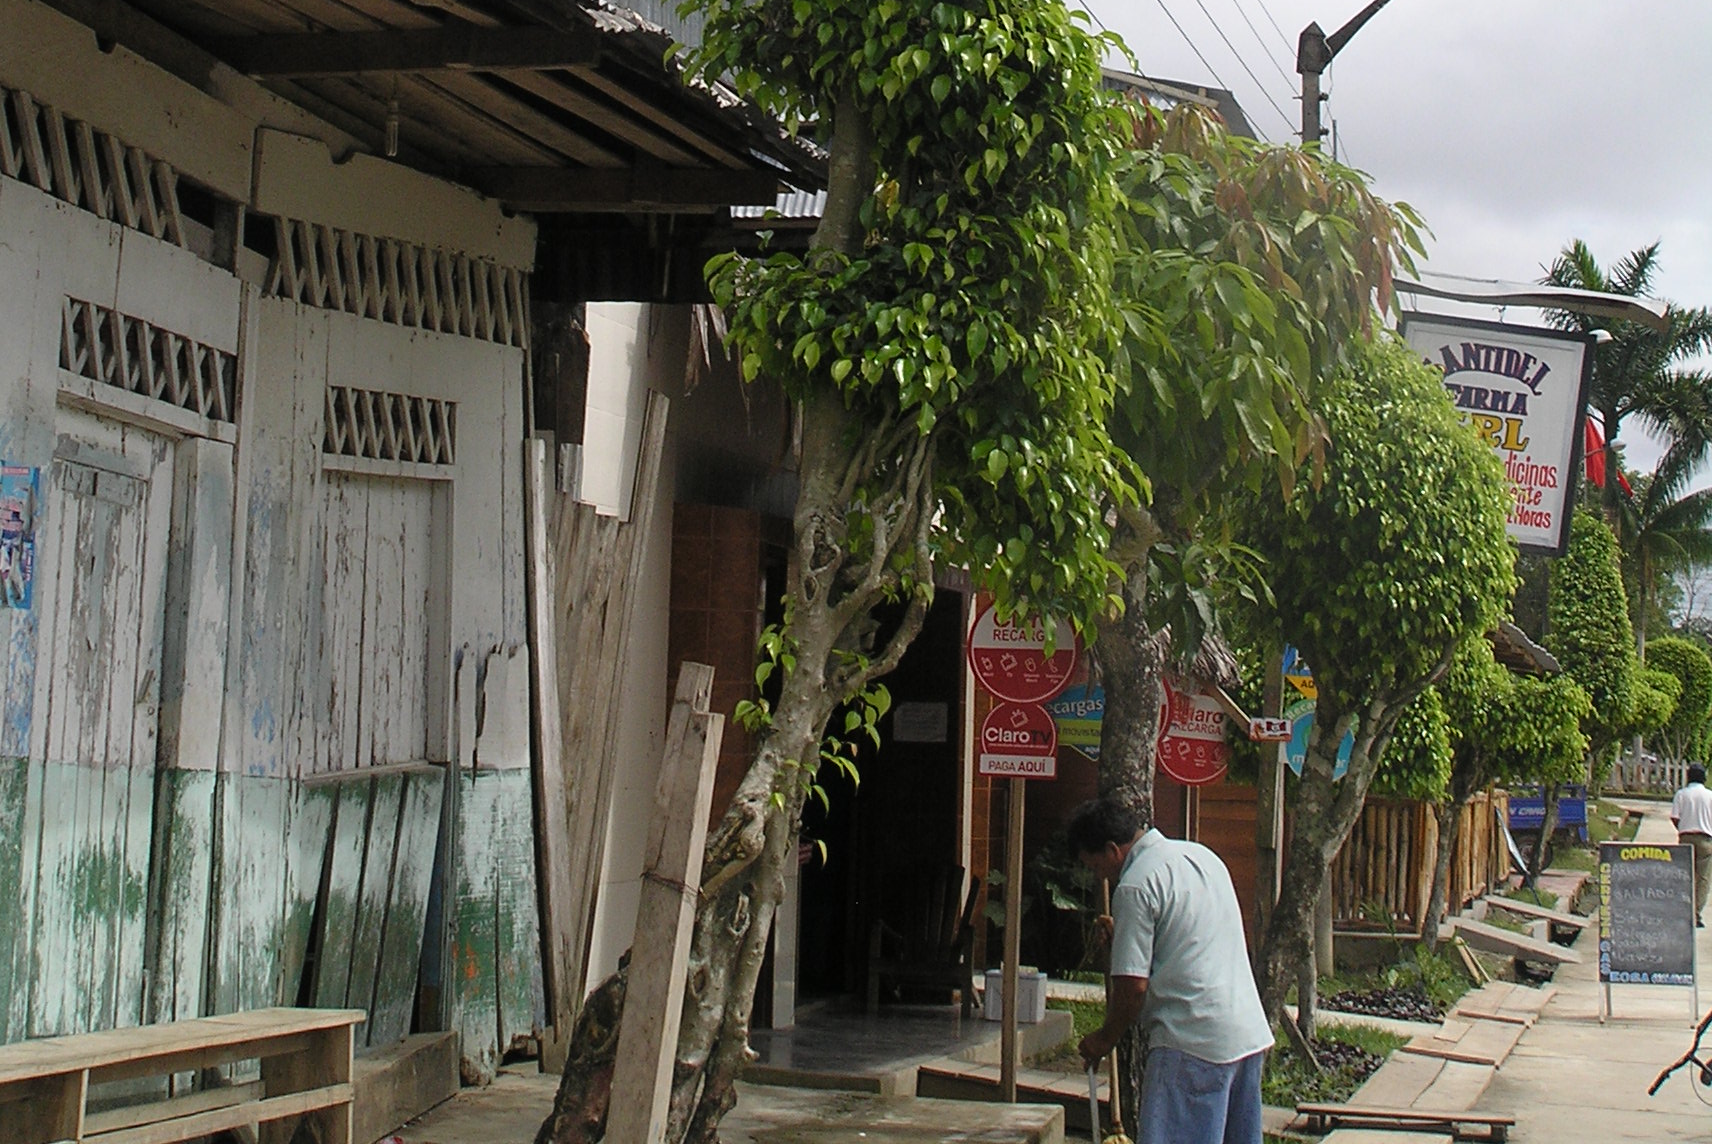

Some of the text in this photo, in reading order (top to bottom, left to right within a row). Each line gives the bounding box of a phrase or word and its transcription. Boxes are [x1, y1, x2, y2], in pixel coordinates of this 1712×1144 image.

[1422, 343, 1551, 395] ANTIDEL
[1504, 450, 1557, 488] dicinas
[993, 629, 1045, 642] RECAG
[1190, 709, 1224, 725] laro
[985, 727, 1051, 745] Claro TV
[988, 759, 1046, 773] PAGA AQUÍ
[1620, 847, 1672, 862] COMIDA
